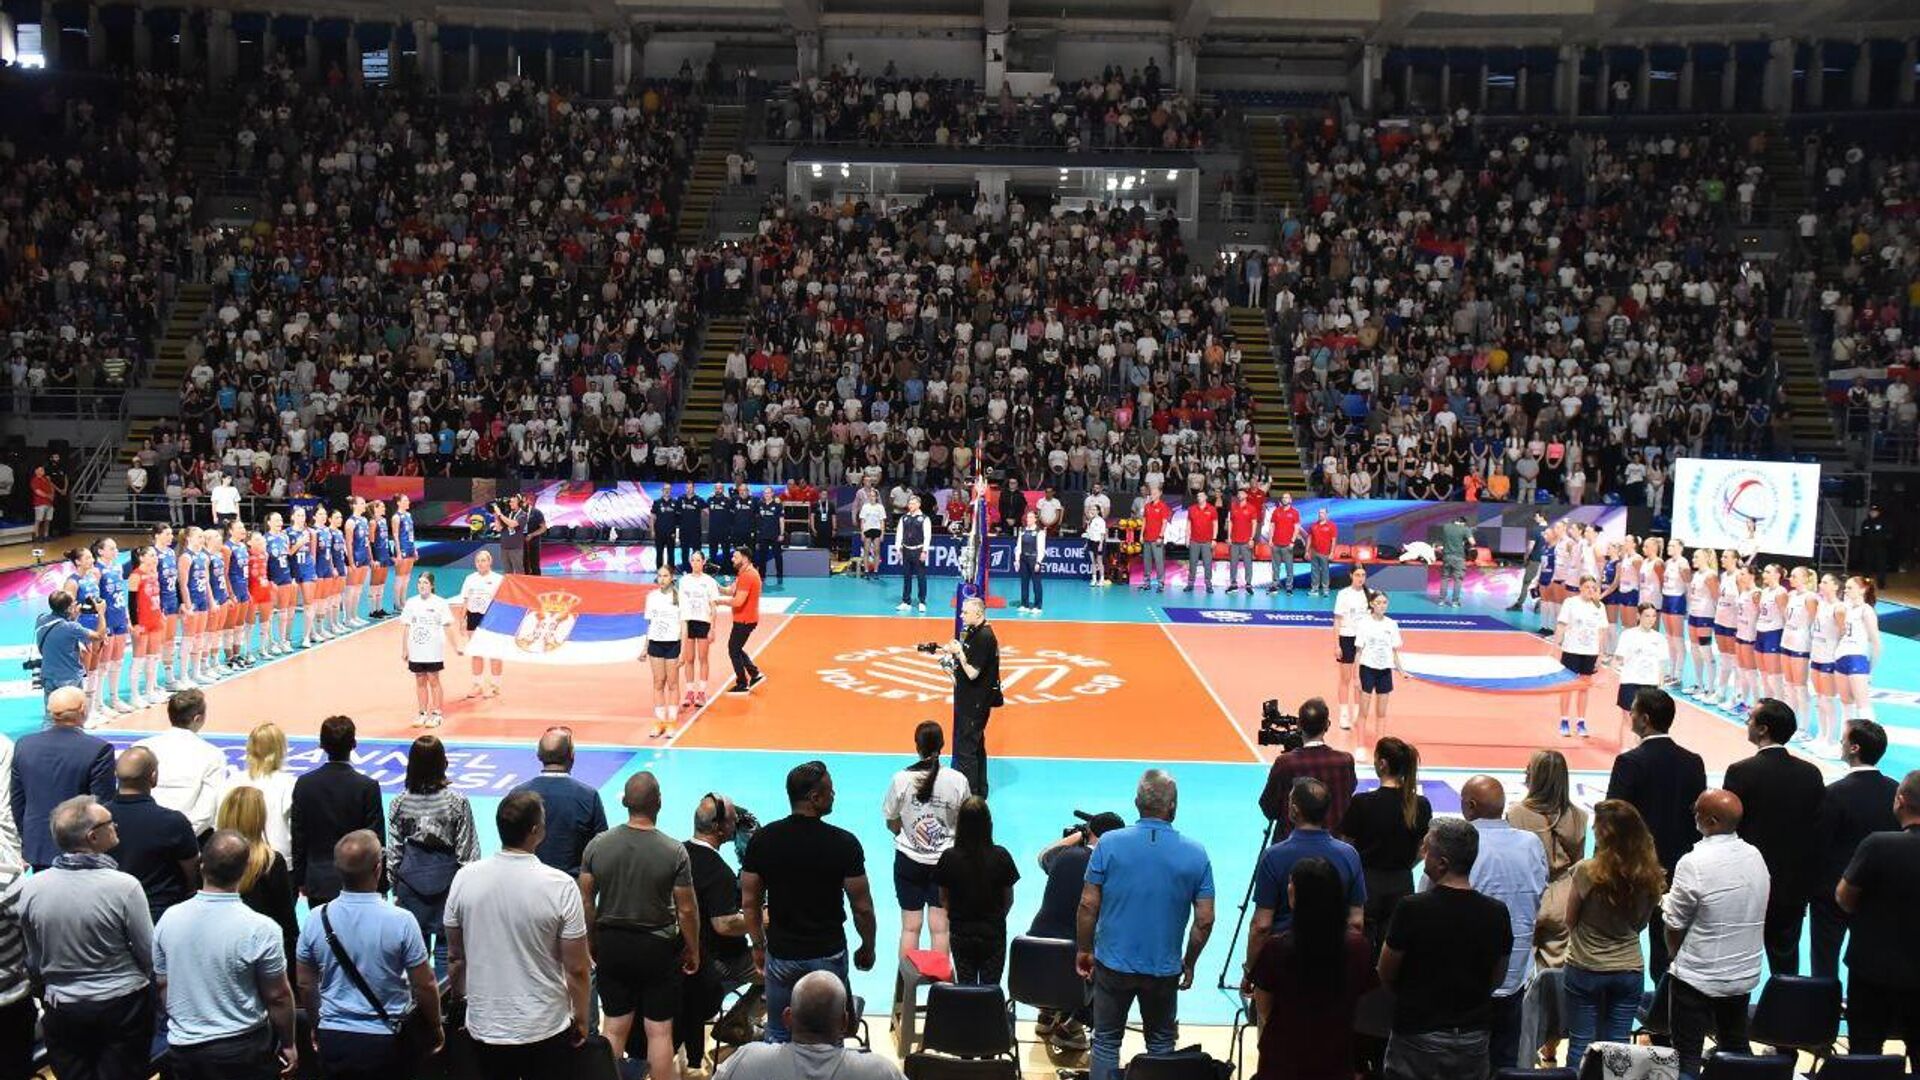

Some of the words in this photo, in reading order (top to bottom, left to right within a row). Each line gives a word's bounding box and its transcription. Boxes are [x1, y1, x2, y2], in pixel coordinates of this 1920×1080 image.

[1043, 547, 1061, 558] NEL
[1064, 547, 1085, 558] ONE
[1040, 563, 1078, 574] EYBALL
